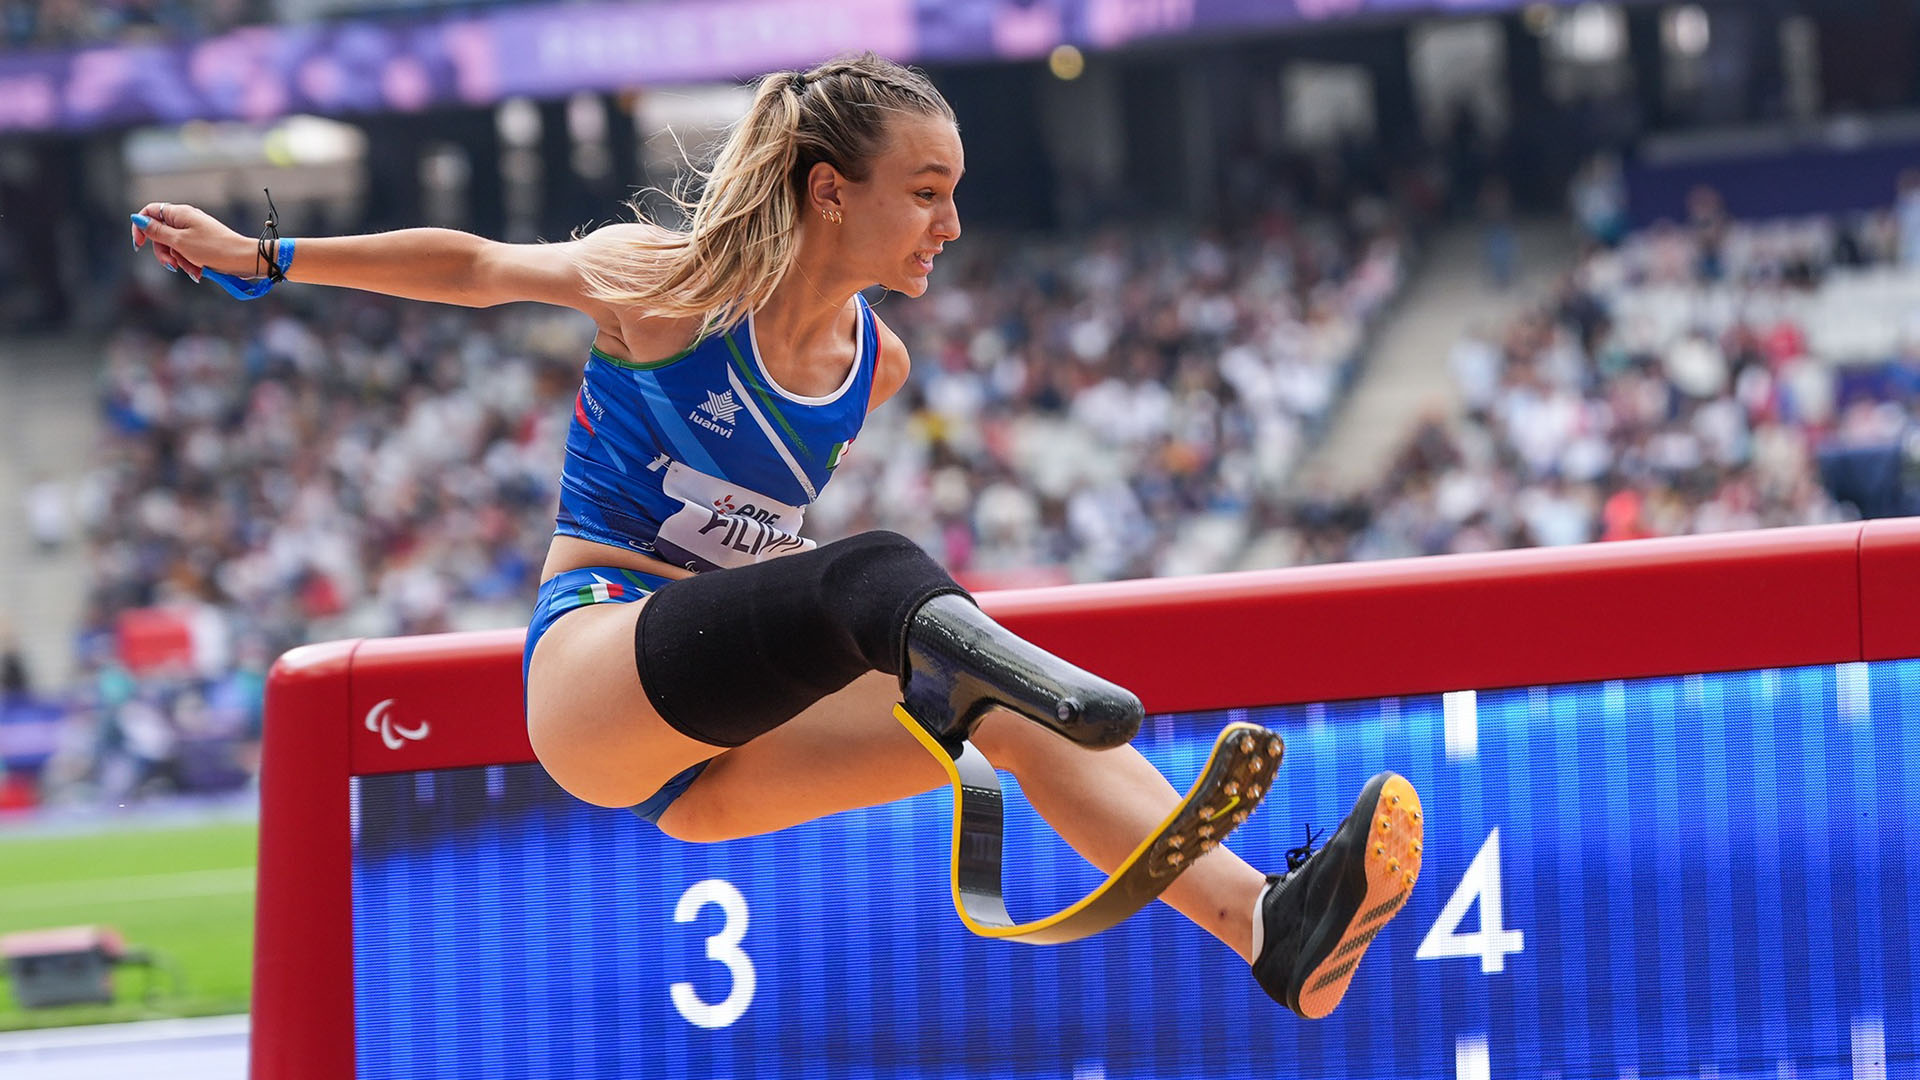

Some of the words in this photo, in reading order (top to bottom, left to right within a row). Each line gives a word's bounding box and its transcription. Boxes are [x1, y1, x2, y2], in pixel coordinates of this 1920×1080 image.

[688, 410, 734, 439] luanvi
[669, 879, 757, 1028] 3
[1415, 826, 1524, 974] 4
